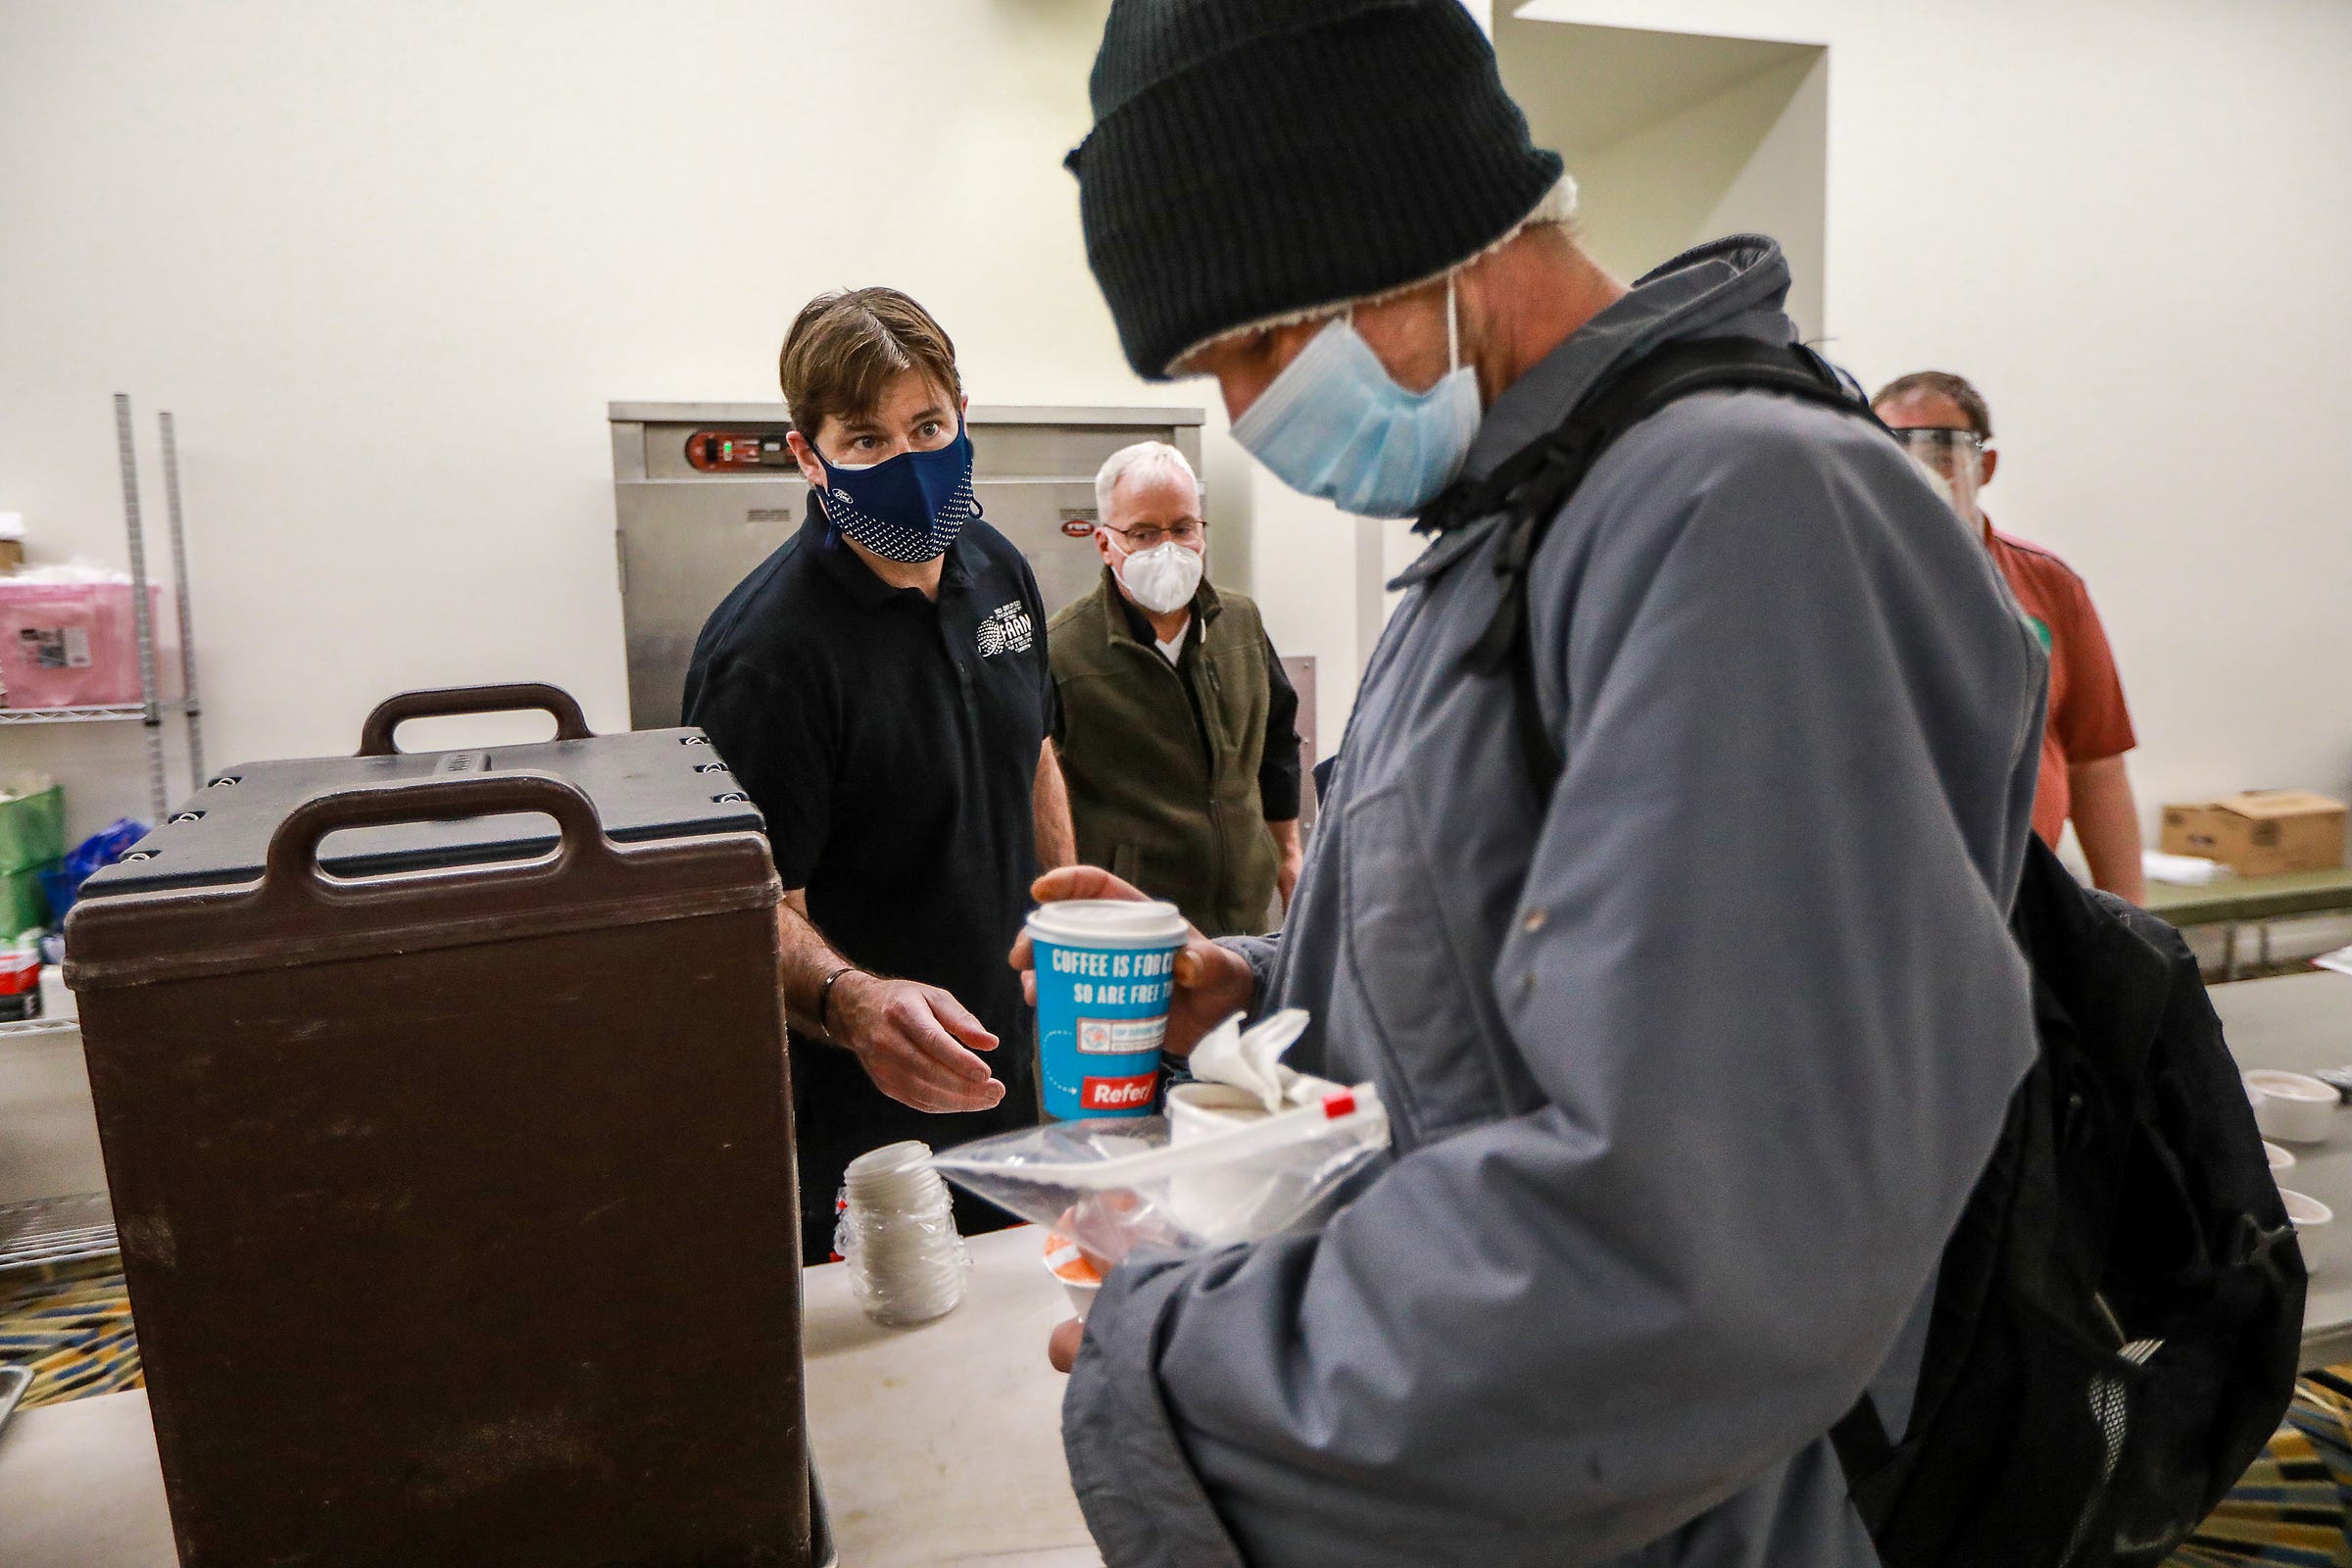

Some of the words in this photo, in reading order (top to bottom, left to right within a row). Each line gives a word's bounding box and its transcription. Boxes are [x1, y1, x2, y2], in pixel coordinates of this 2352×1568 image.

[1053, 949, 1109, 977] COFFEE
[1112, 955, 1130, 978] IS
[1133, 954, 1161, 977] FOR
[1074, 983, 1094, 1004] SO
[1097, 985, 1126, 1004] ARE
[1130, 984, 1159, 1004] FREE
